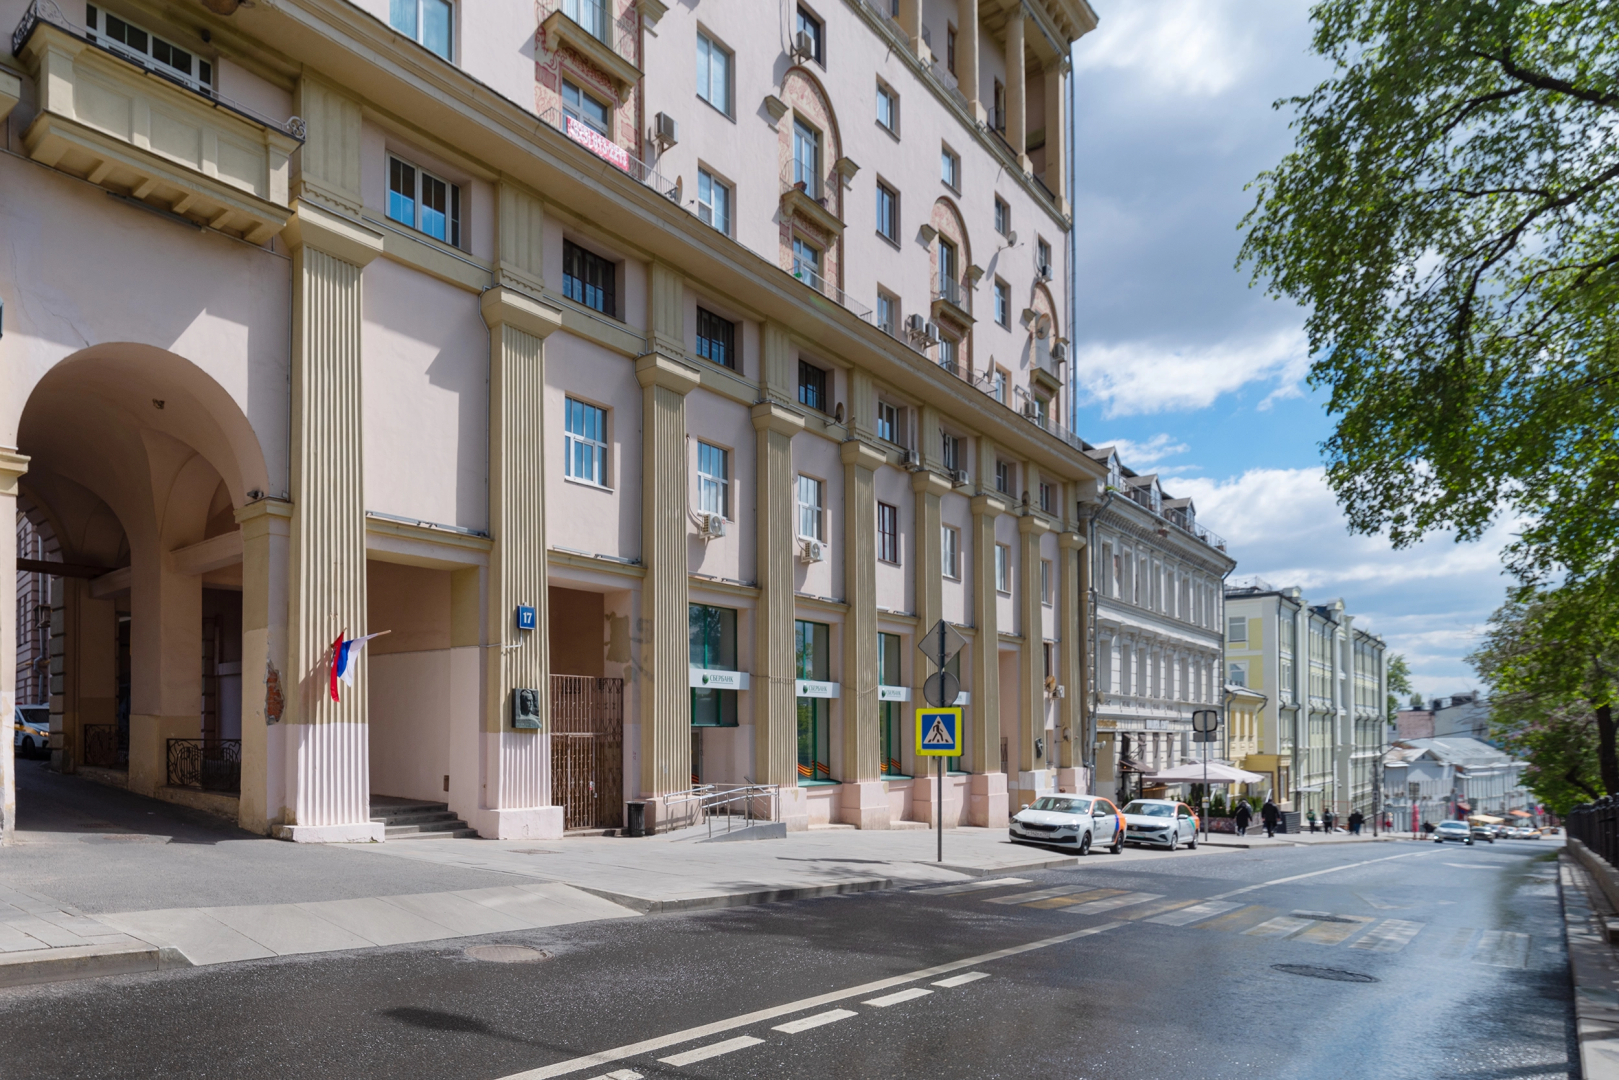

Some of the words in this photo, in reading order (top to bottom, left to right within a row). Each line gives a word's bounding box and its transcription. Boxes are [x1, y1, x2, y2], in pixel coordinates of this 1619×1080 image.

[523, 612, 532, 623] 17
[710, 674, 734, 682] СБЕРБАНК
[809, 684, 828, 692] СБЕРБАНК
